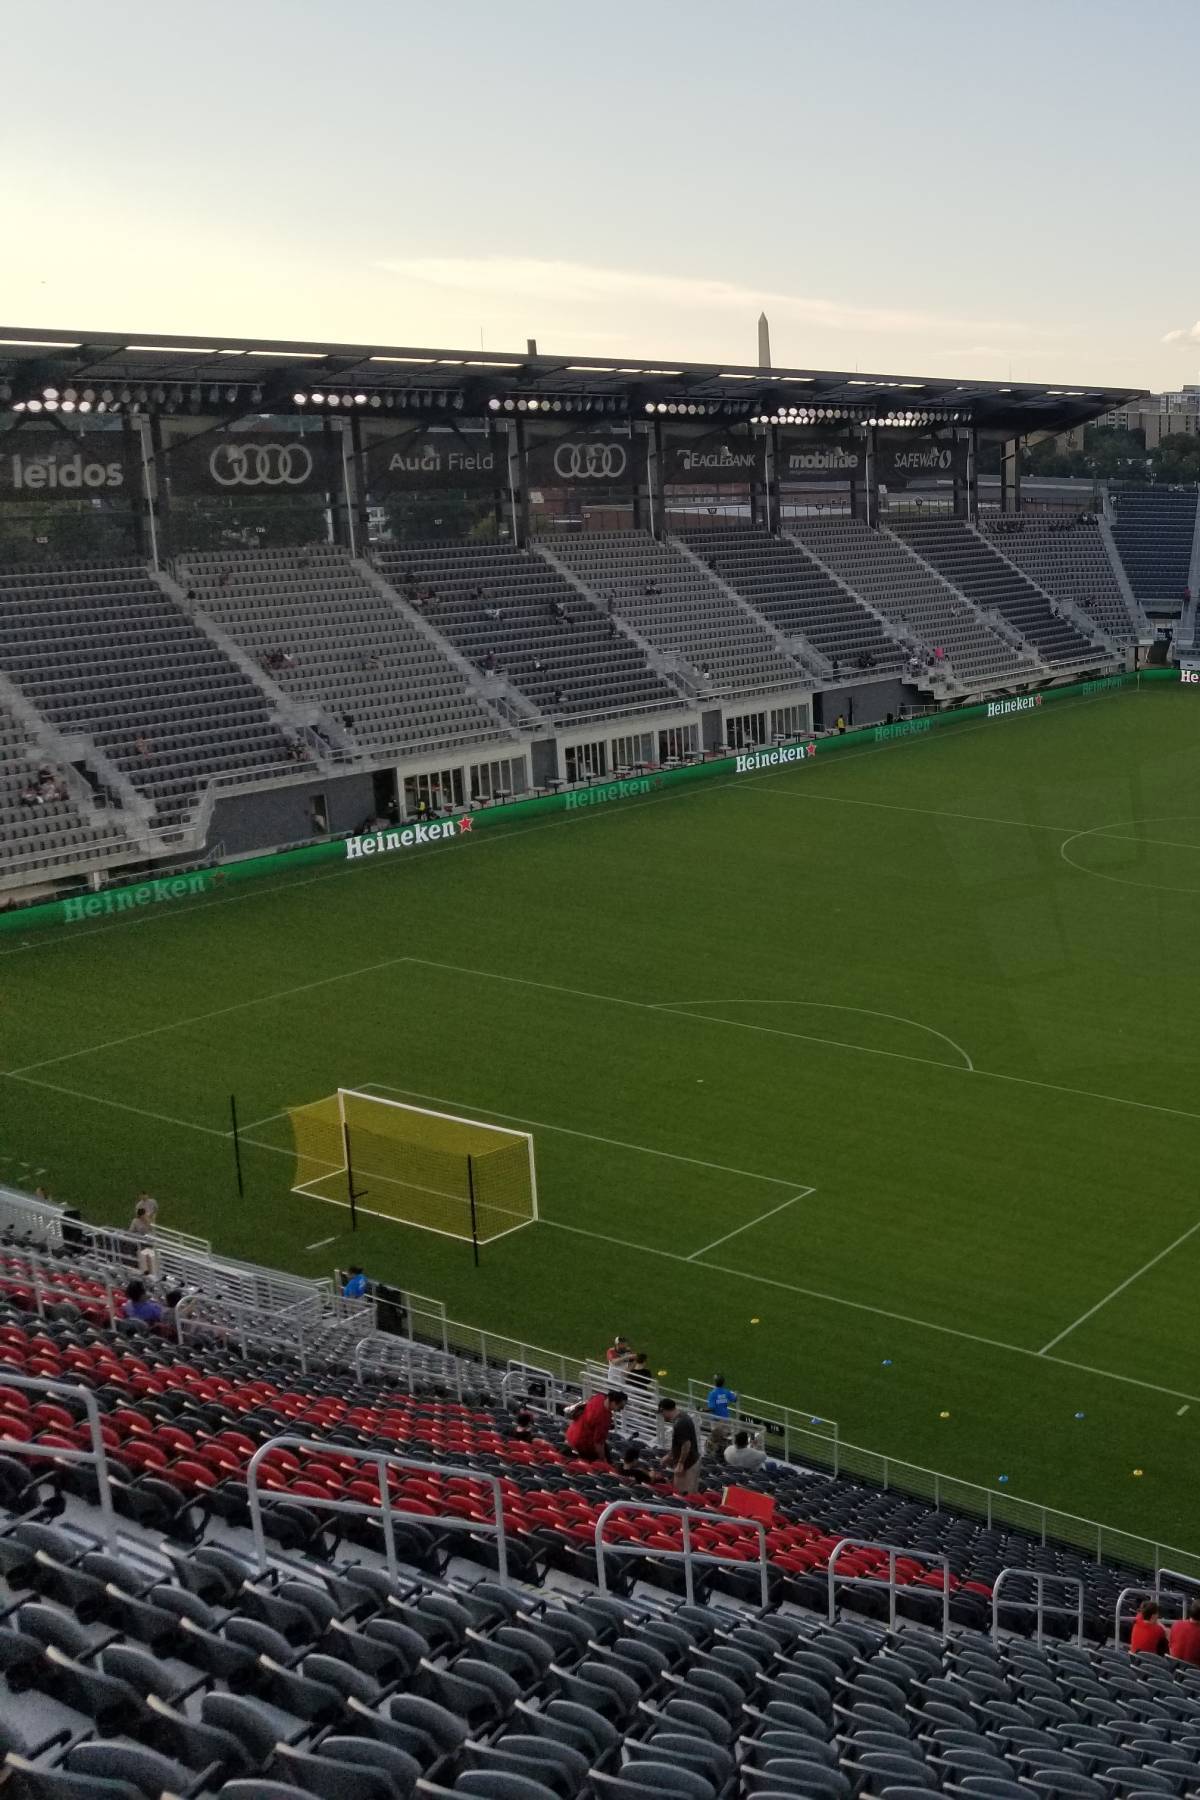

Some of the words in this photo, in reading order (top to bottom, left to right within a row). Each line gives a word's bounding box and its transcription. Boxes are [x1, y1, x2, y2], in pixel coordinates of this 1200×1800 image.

[11, 453, 124, 488] leidos
[388, 452, 441, 471] Audi
[448, 452, 494, 471] Field
[691, 451, 757, 467] EAGLEBANK
[986, 696, 1035, 717] Heineken
[874, 718, 930, 742] Heineken
[735, 744, 806, 773] Heineken
[564, 777, 651, 810] Heineken
[345, 818, 457, 859] Heineken
[63, 873, 207, 923] Heineken
